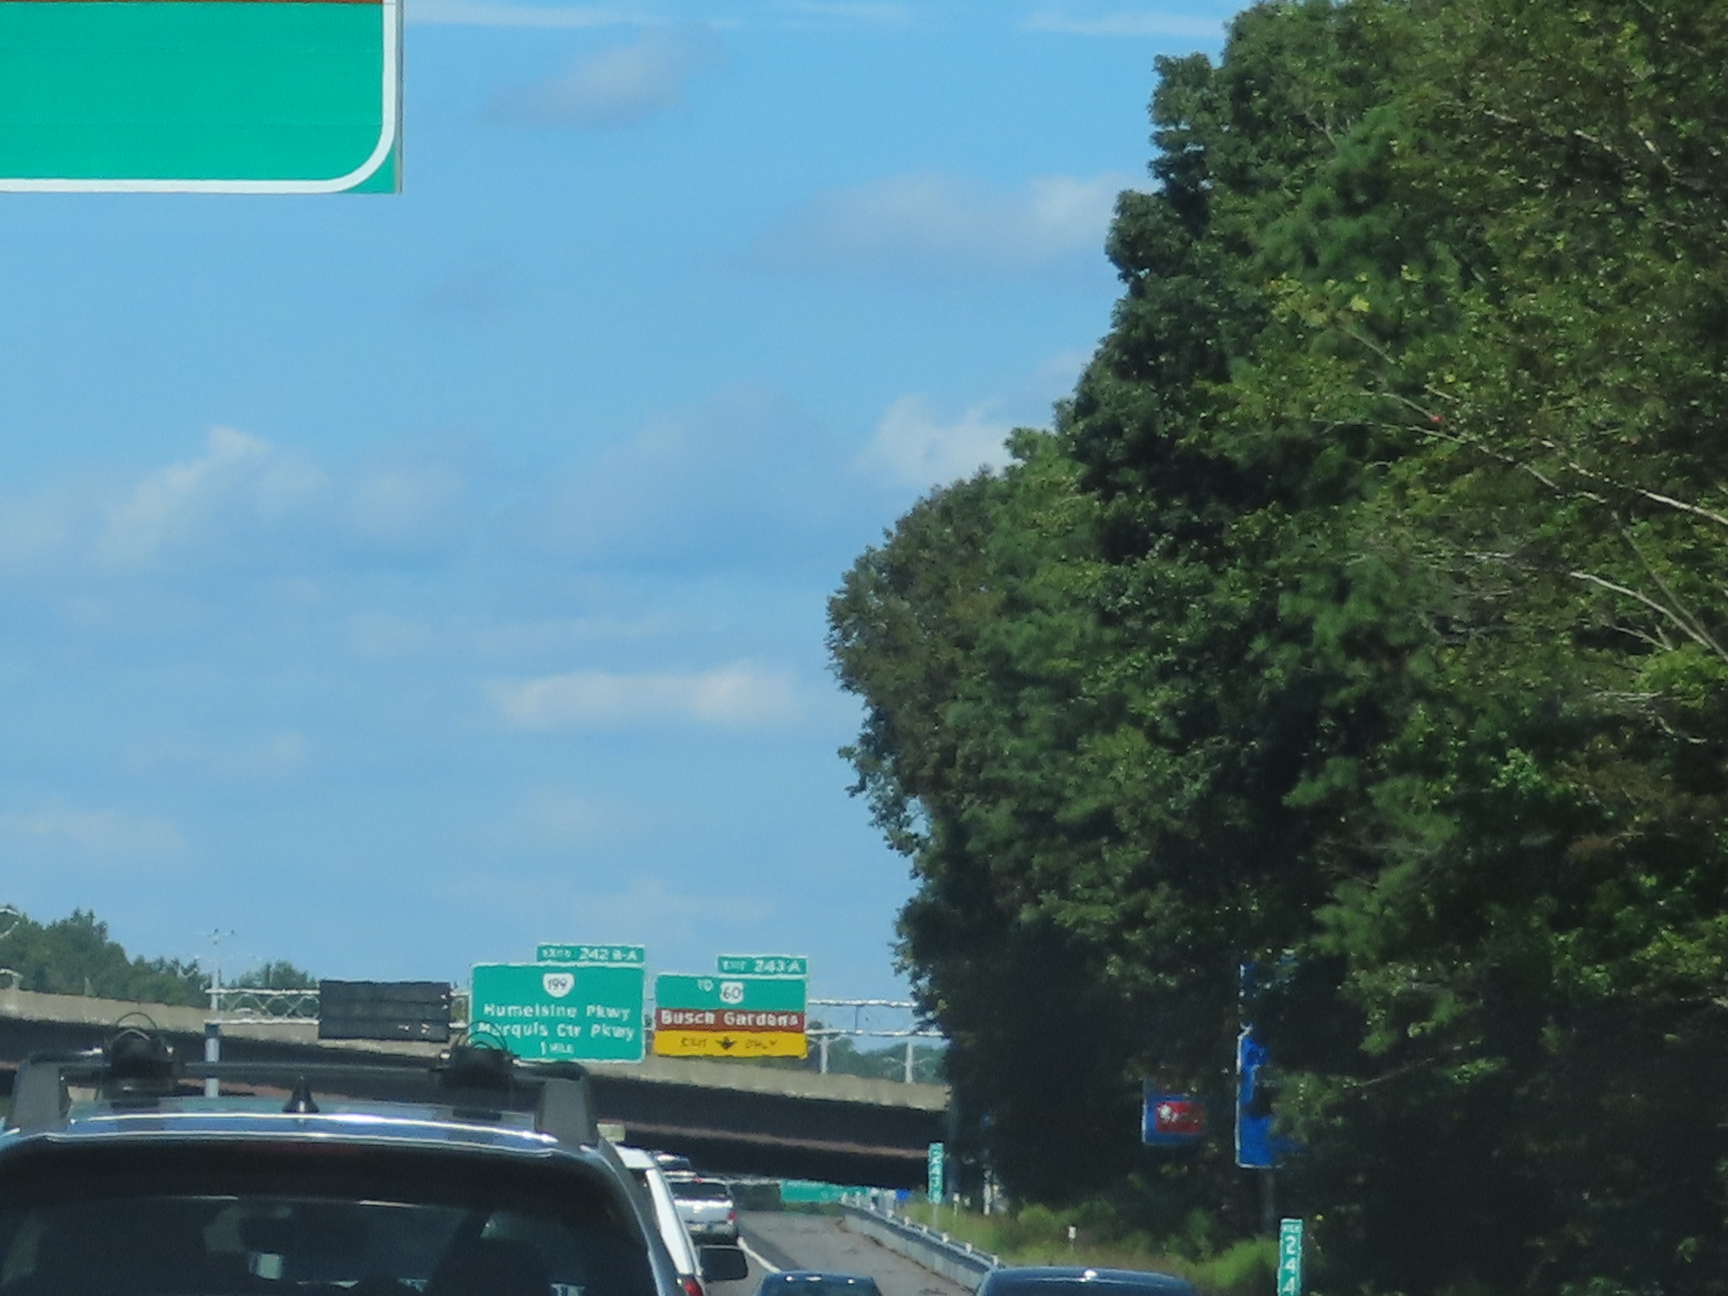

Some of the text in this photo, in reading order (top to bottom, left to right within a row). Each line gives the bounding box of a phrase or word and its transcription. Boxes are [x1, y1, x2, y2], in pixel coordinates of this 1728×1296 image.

[579, 947, 609, 960] 242
[753, 960, 785, 972] 243
[788, 960, 801, 972] A
[547, 977, 568, 990] 199
[697, 979, 714, 992] TO
[723, 986, 742, 1000] 60
[483, 1003, 631, 1022] Humelsine Pkwy
[661, 1009, 799, 1027] Busch Gardens
[477, 1021, 635, 1042] Marquis Ctr Pkwy
[540, 1041, 547, 1055] 1
[1282, 1235, 1297, 1296] 244
